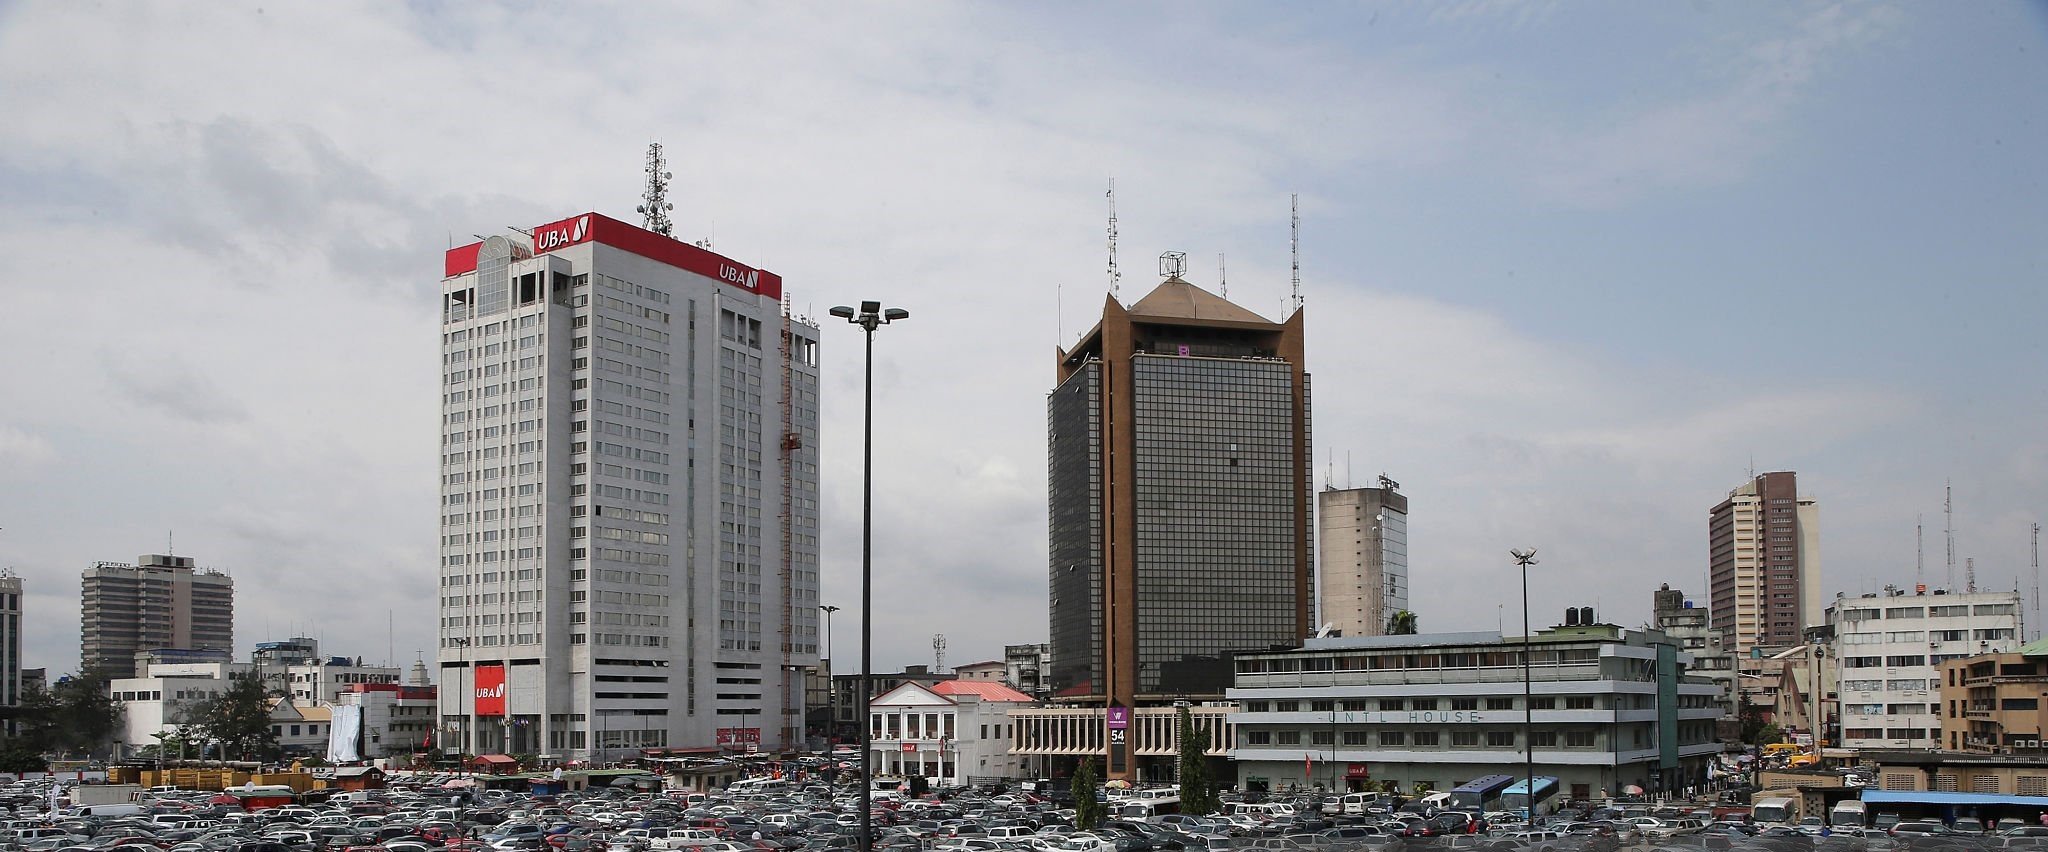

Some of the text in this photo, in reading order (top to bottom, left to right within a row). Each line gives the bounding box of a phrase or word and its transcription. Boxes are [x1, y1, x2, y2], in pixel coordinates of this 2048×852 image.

[538, 227, 569, 249] UBA
[719, 263, 746, 286] UBA
[477, 688, 495, 697] UBA
[1328, 711, 1479, 722] UNTL HOUSE
[1111, 729, 1125, 741] 54
